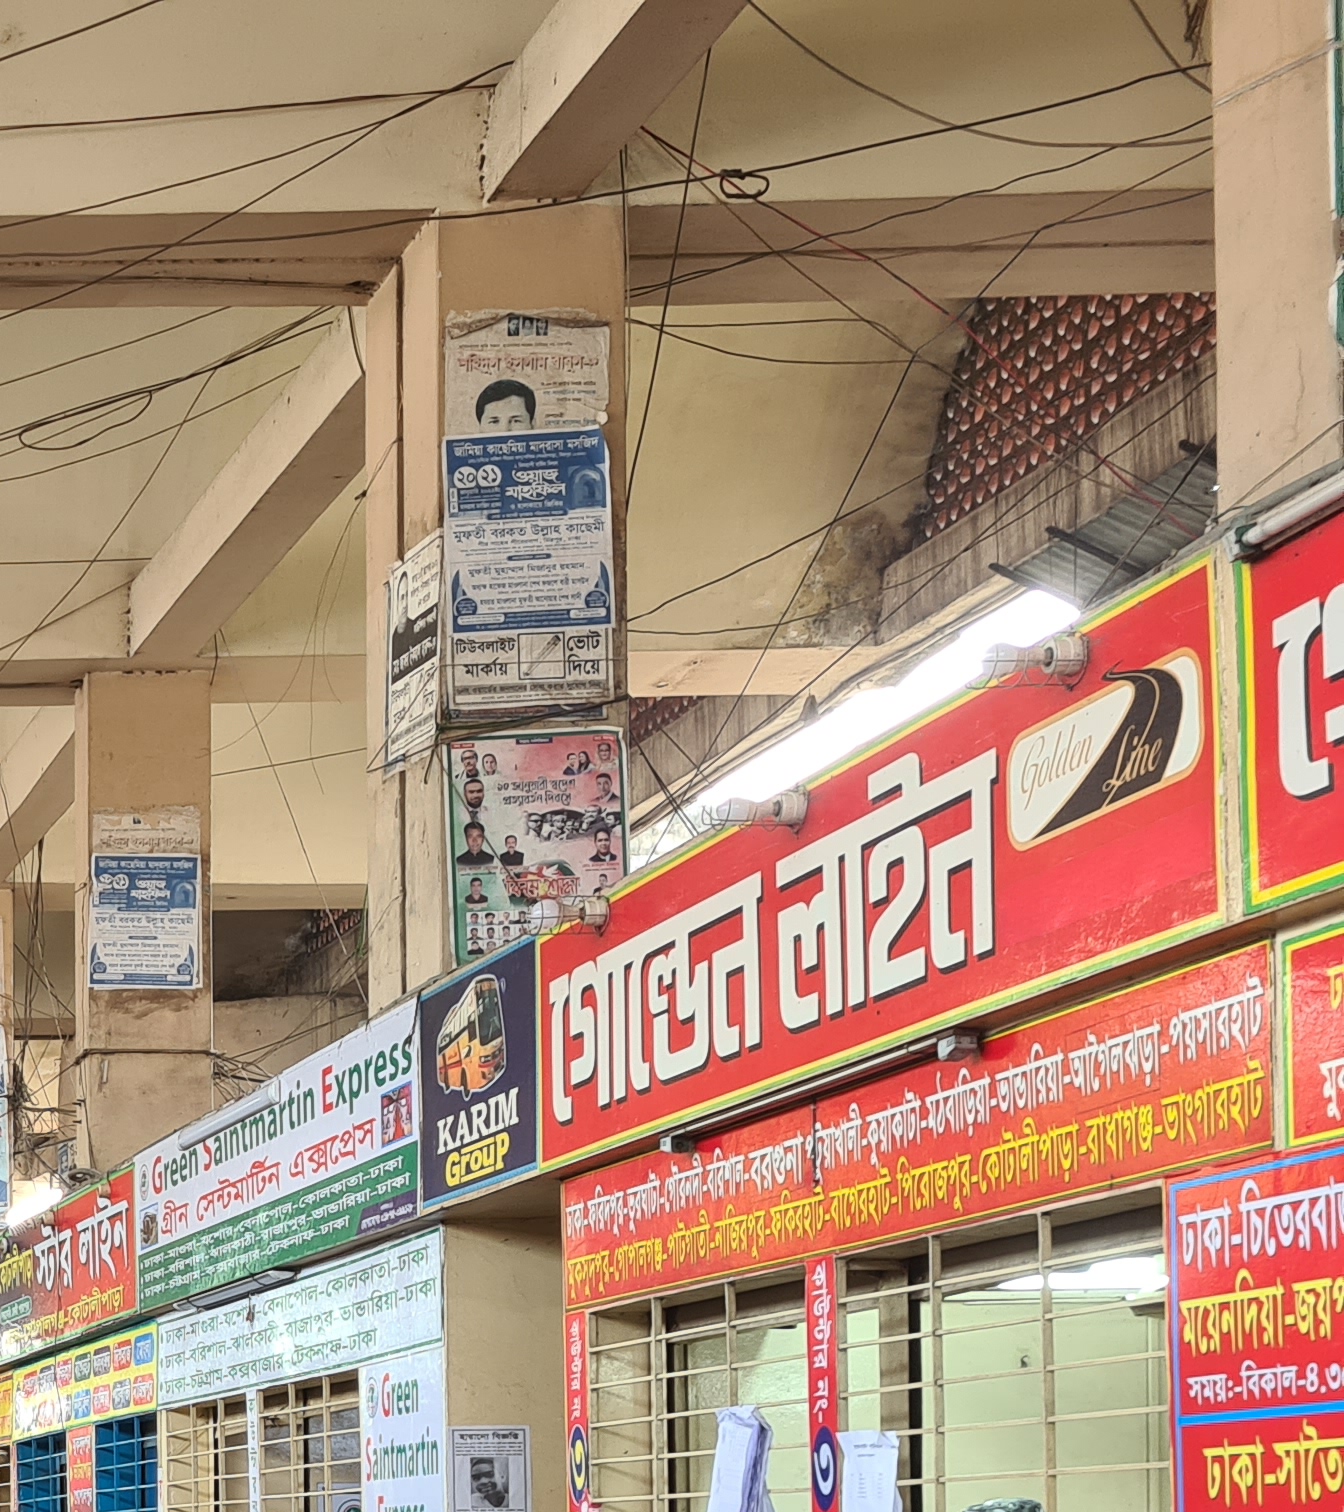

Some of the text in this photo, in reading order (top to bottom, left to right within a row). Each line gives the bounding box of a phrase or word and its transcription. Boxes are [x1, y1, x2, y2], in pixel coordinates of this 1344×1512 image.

[452, 519, 606, 544] মুফতী বরকত উল্লাহ কাছেমী
[454, 629, 602, 655] টিউবলাইট ভোট
[463, 654, 600, 678] মার্কায় দিয়ে
[1020, 723, 1163, 812] Golden Line
[549, 750, 1000, 1124] গোল্ডেন লাইন
[152, 1036, 413, 1197] Green Saintmartin Express
[436, 1086, 520, 1156] KARIM
[160, 1117, 378, 1239] গ্রীন সেন্টমার্টিন এক্সপ্রেস
[33, 1197, 130, 1292] স্টার লাইন
[380, 1371, 420, 1419] Green
[365, 1425, 440, 1483] Saintmartin
[1201, 1418, 1344, 1509] ঢাকা-সাতৈ
